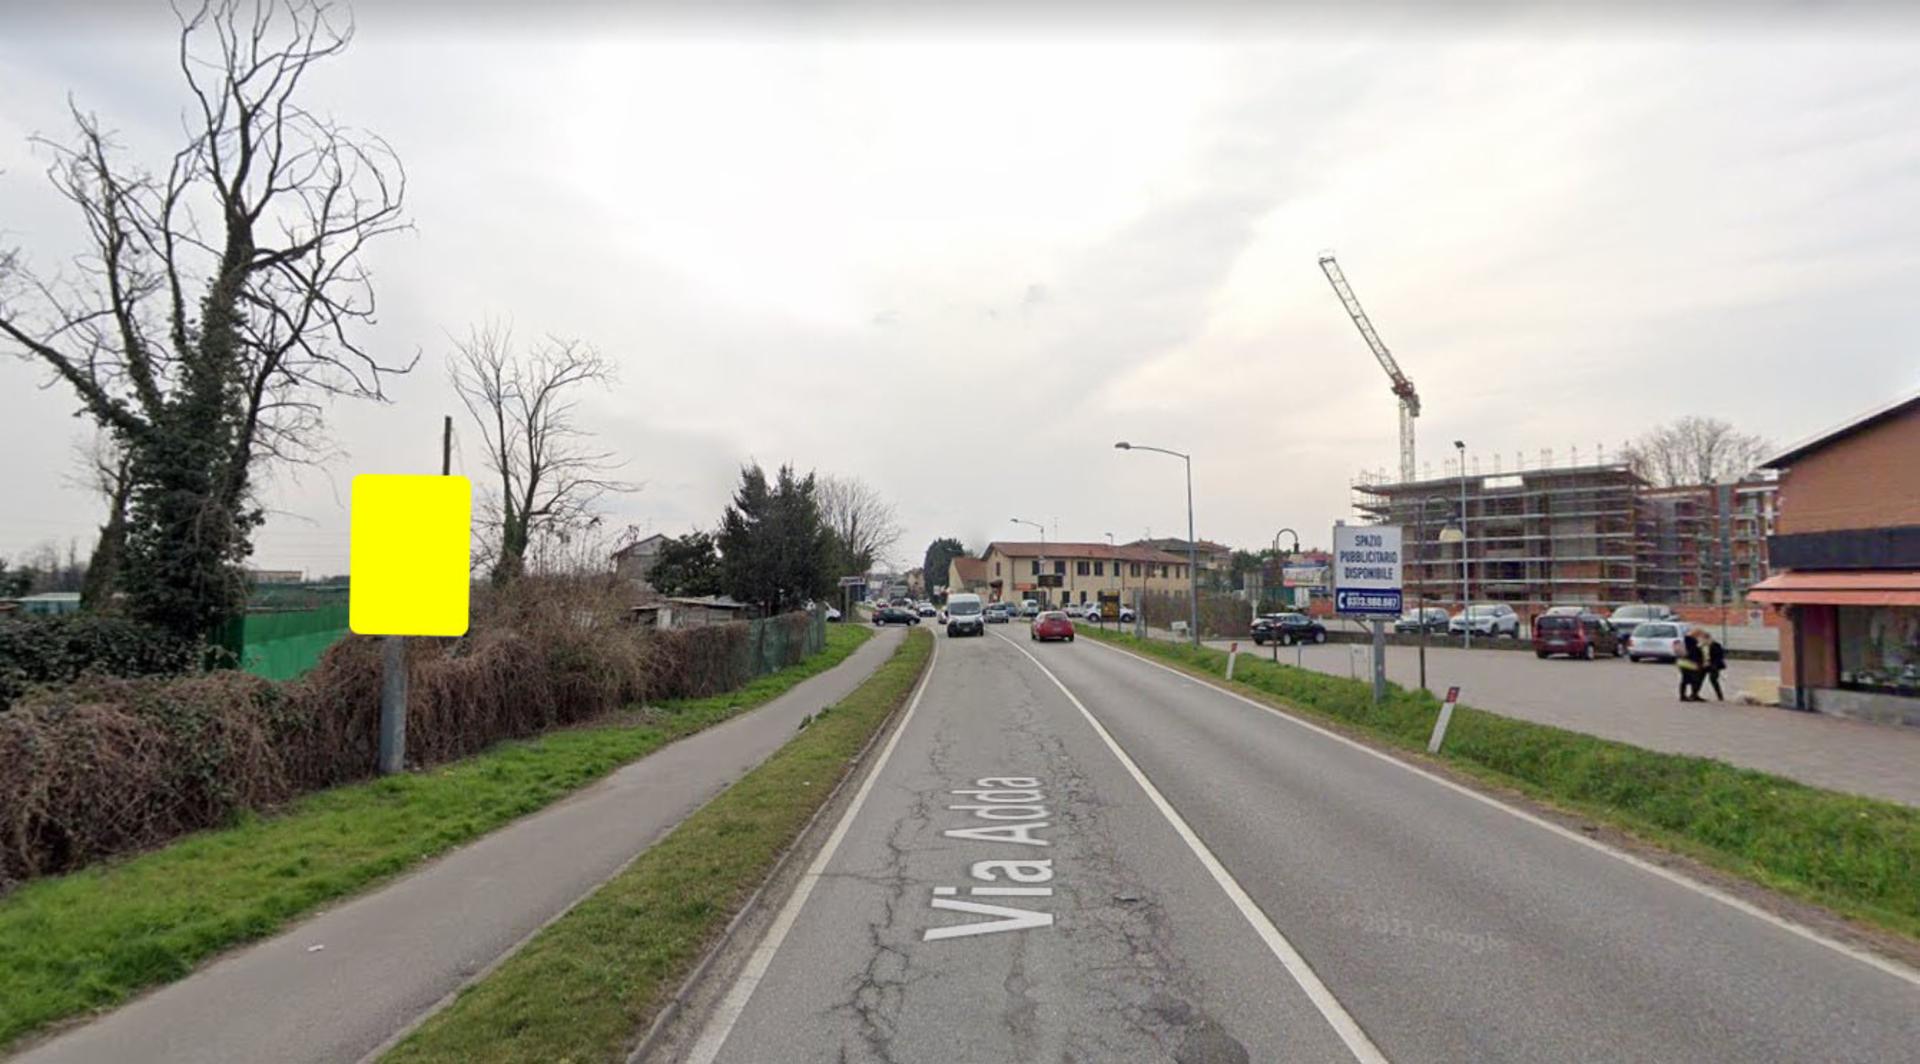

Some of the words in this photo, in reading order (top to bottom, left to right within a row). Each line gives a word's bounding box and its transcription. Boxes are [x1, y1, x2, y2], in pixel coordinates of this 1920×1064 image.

[1354, 535, 1383, 547] SPAZIO
[1340, 551, 1398, 564] PUBBLICITARIO
[1344, 567, 1393, 580] DISPONIBILE
